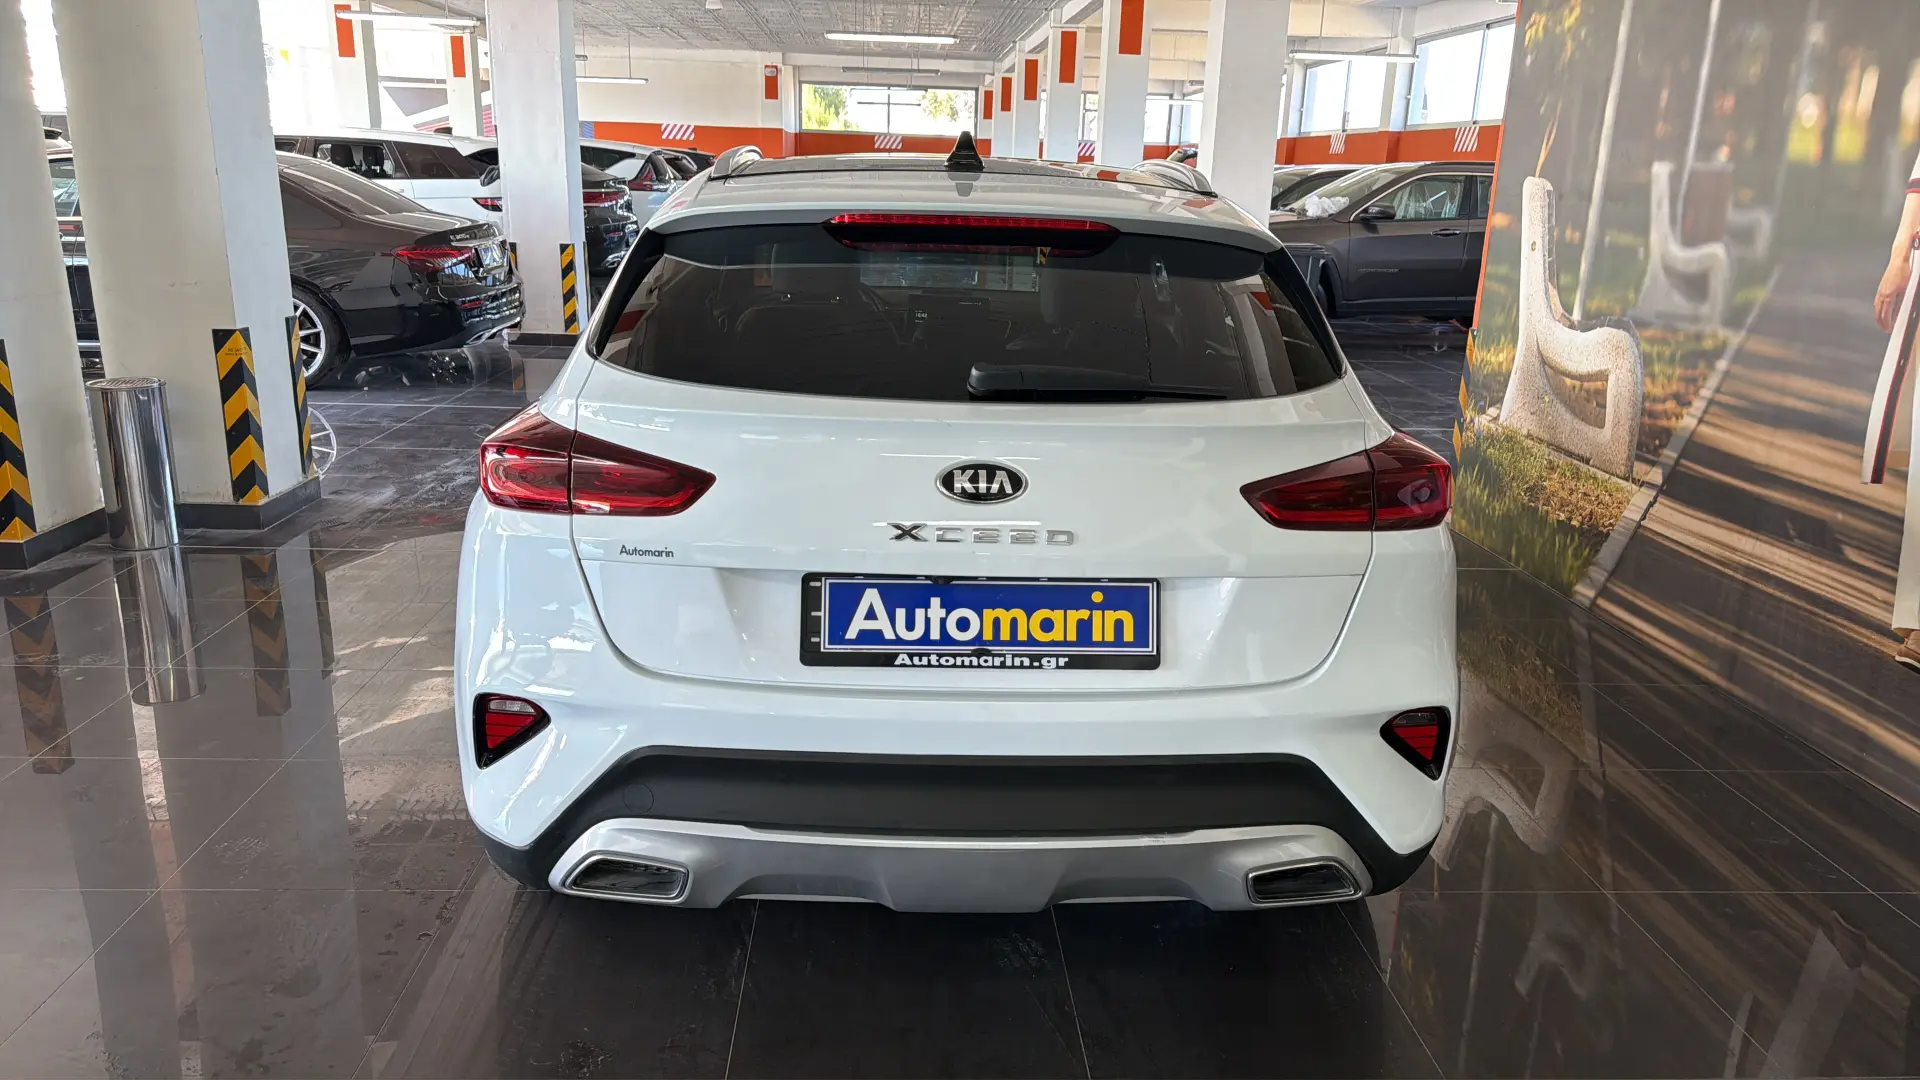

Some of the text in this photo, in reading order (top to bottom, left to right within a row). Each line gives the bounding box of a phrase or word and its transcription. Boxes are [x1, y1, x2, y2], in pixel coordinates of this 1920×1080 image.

[952, 469, 1014, 494] KIA
[889, 522, 1078, 546] XCEED
[619, 544, 674, 558] Automarin
[845, 588, 1134, 642] Automarin
[893, 653, 1069, 669] Automarin.gr
